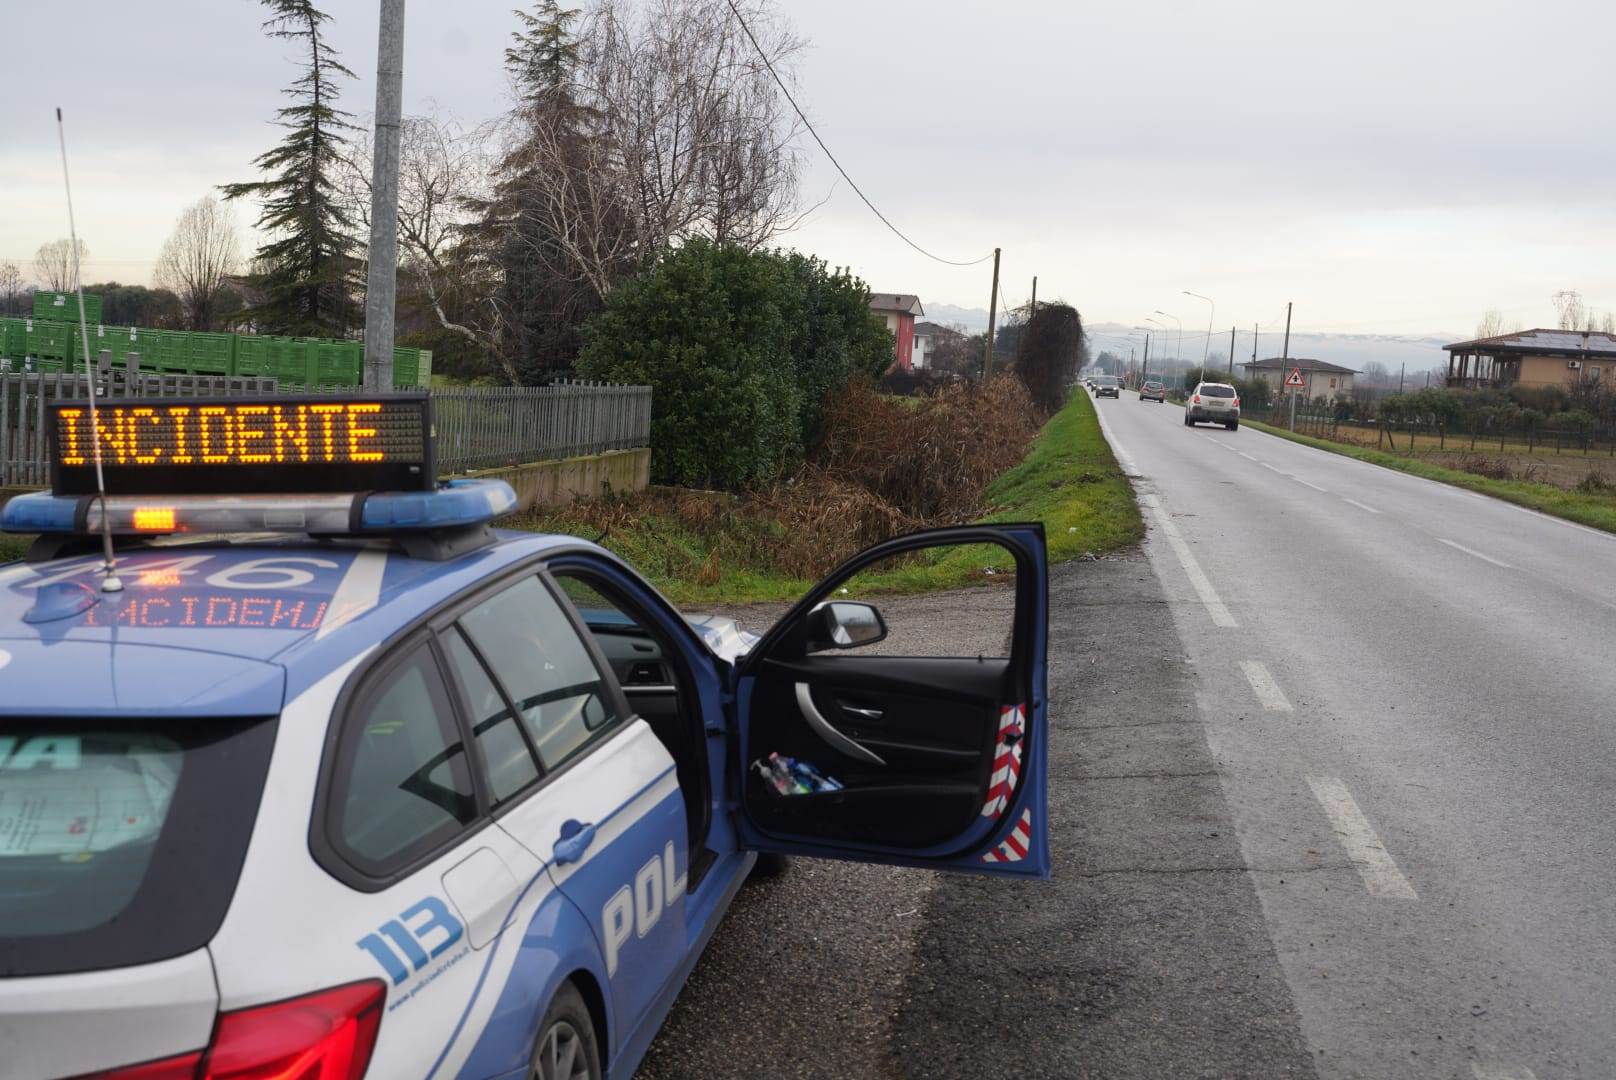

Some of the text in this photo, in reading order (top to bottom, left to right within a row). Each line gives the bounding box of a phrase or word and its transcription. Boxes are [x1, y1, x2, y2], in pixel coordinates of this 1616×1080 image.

[59, 404, 384, 465] INCIDENTE
[356, 896, 464, 986] 113
[602, 839, 688, 980] POL
